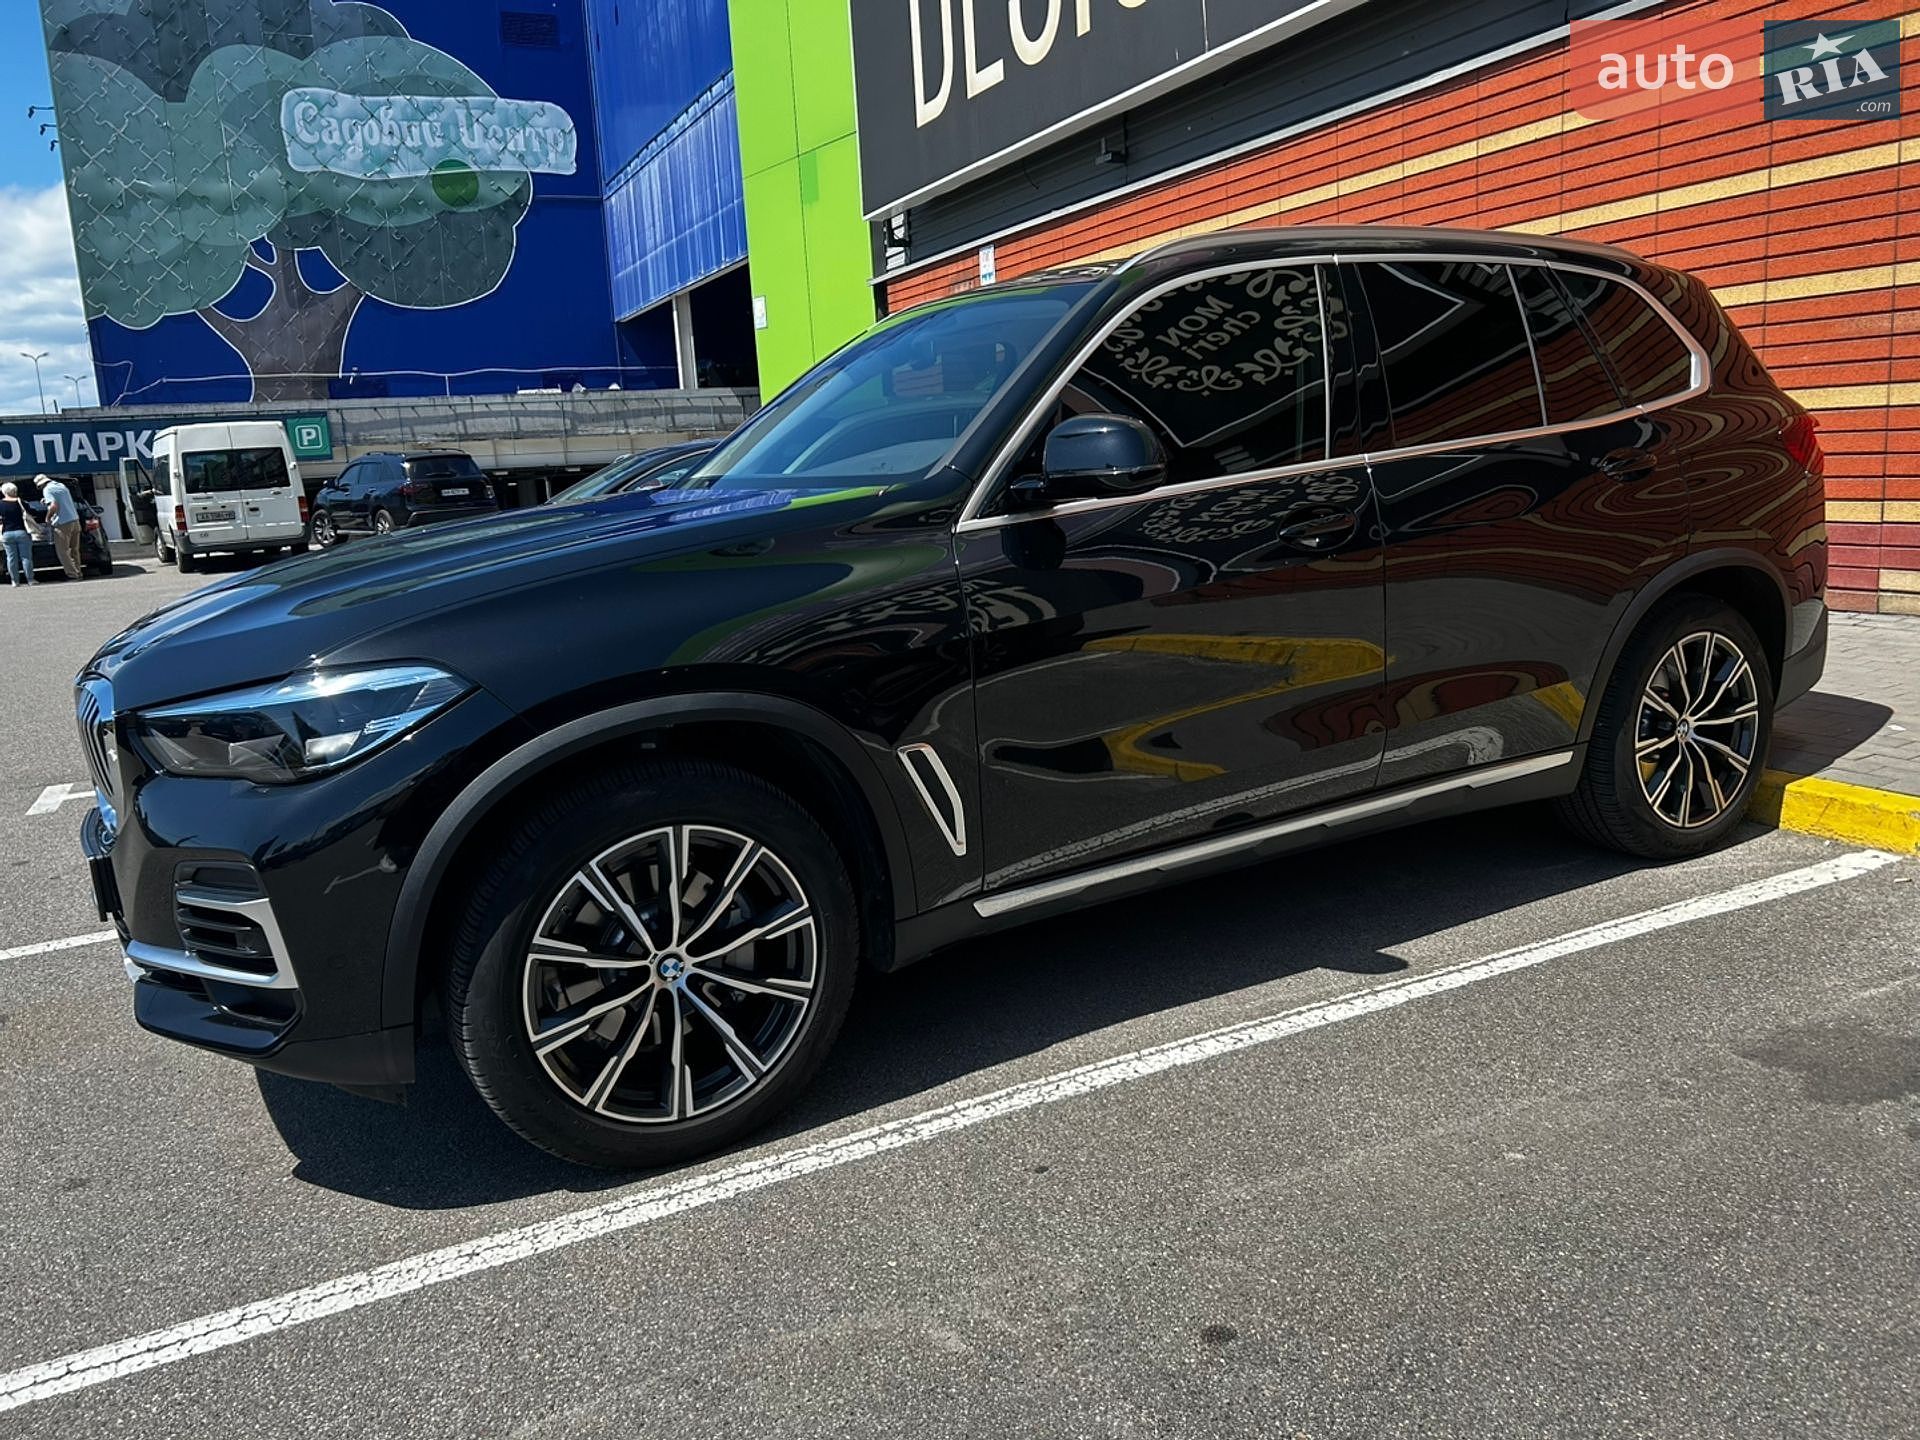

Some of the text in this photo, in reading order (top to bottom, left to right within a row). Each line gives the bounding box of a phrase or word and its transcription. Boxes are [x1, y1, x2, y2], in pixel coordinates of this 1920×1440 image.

[293, 100, 567, 164] Садовий Центр
[33, 429, 160, 464] ПАРК
